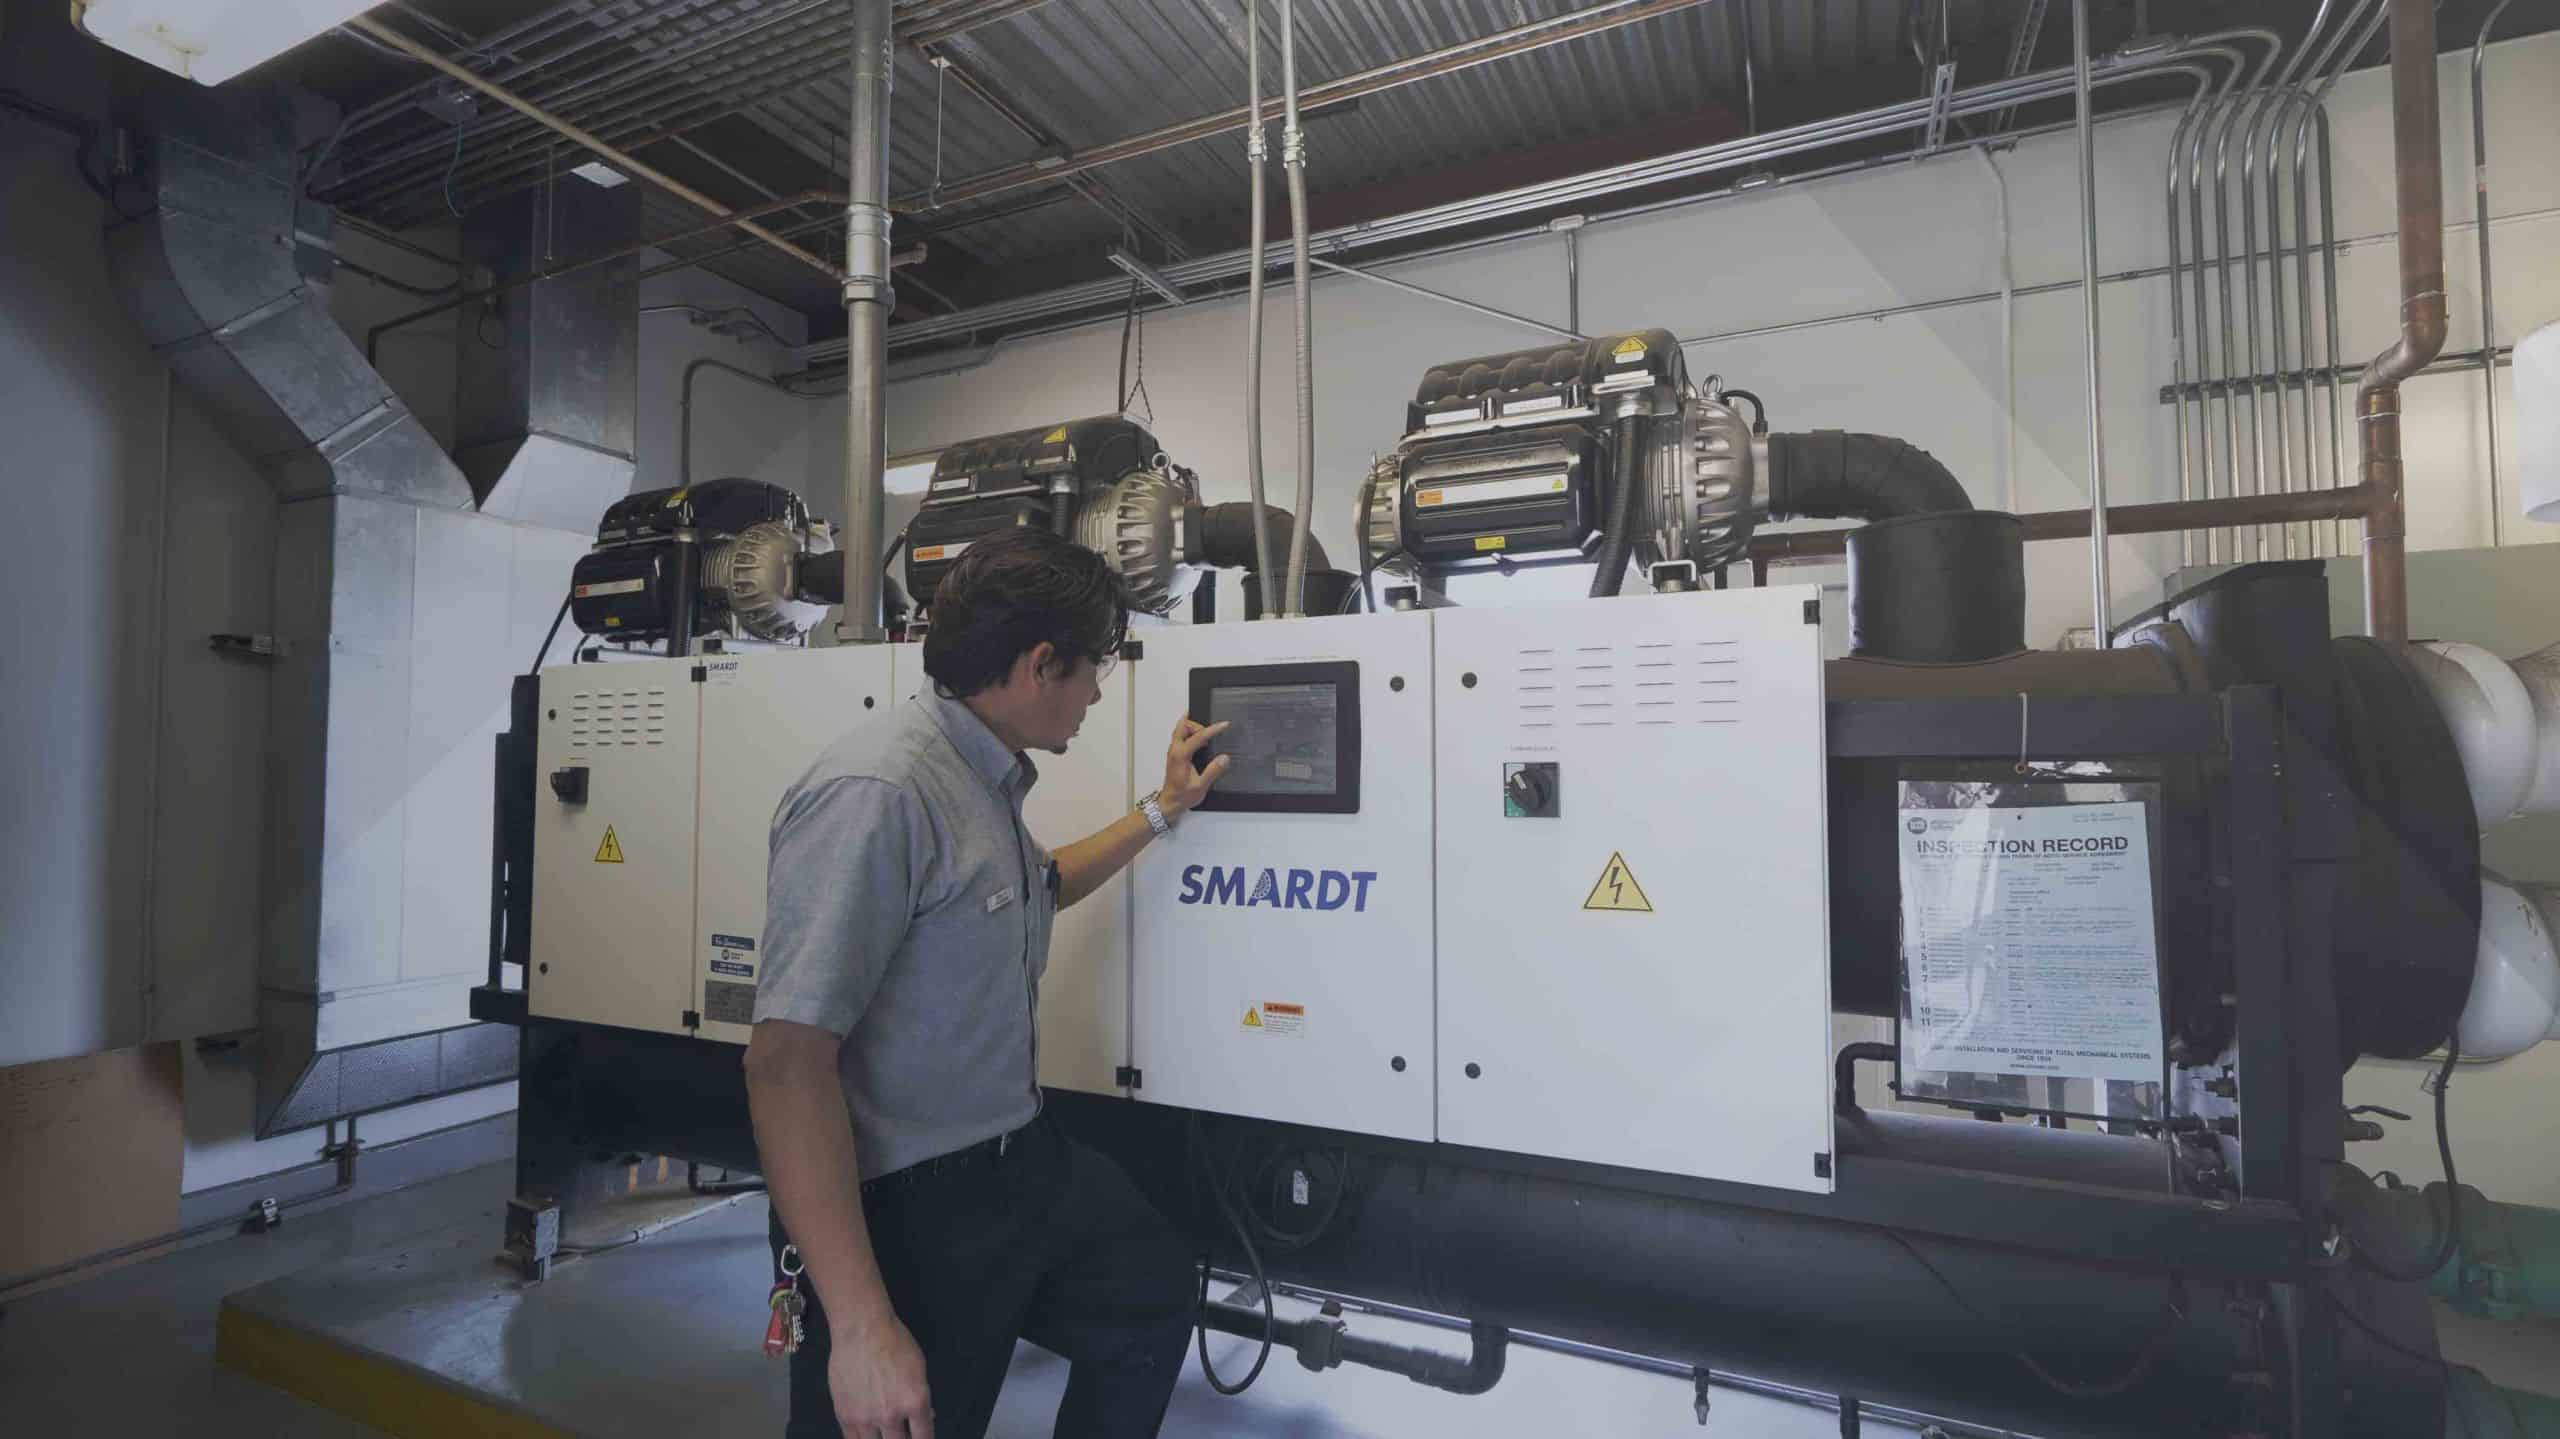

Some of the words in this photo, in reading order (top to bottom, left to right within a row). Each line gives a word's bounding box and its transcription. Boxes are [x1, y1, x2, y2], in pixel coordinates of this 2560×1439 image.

[708, 660, 739, 672] SMARDT
[2042, 836, 2129, 853] RECORD
[1178, 864, 1378, 913] SMARDT
